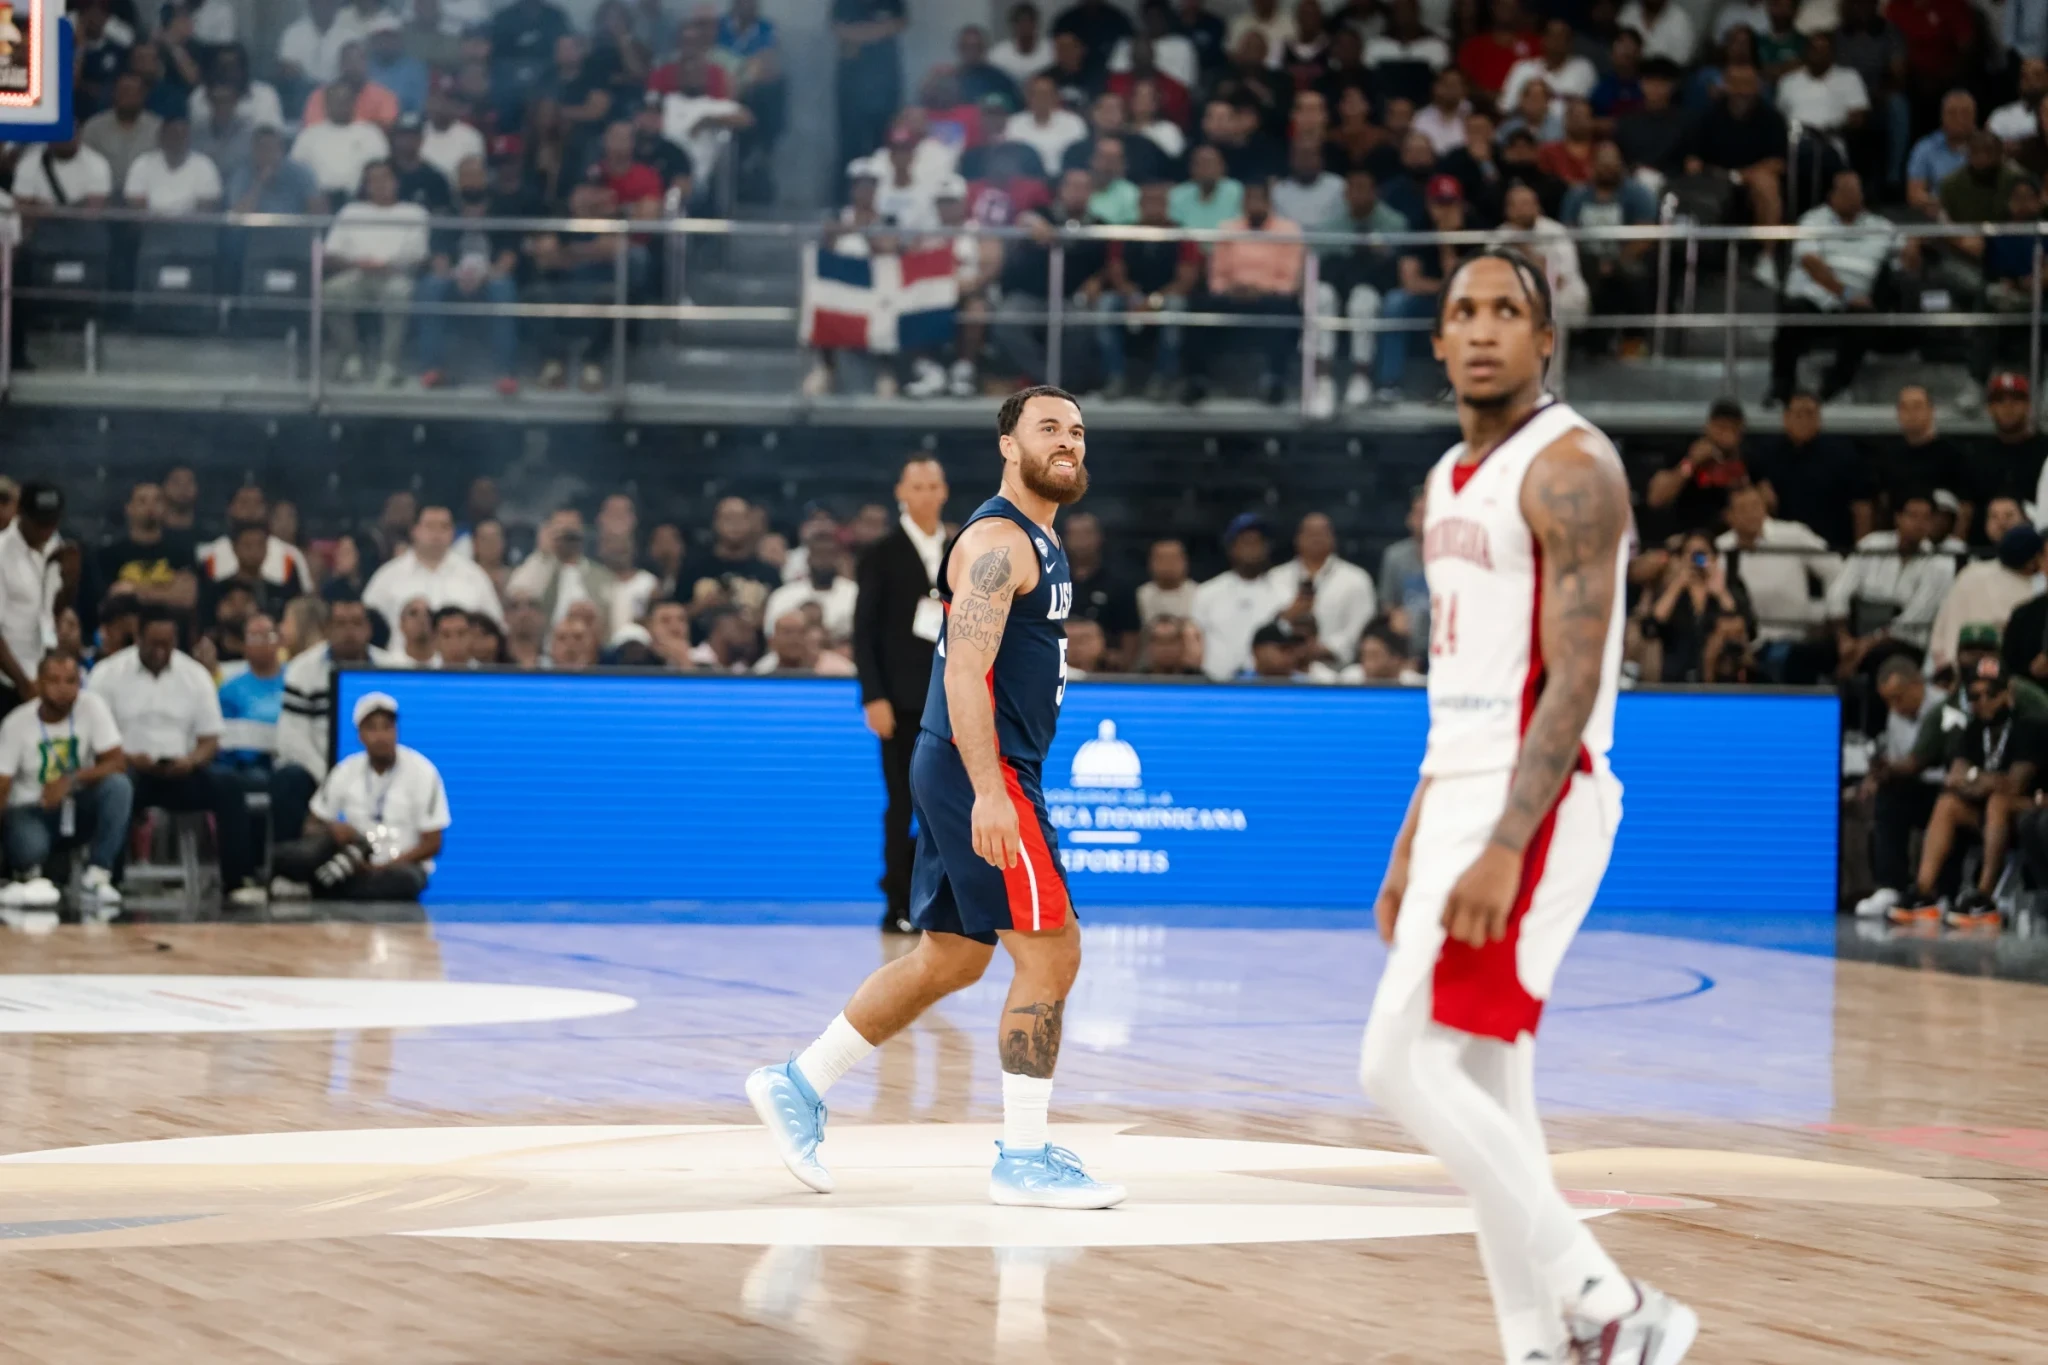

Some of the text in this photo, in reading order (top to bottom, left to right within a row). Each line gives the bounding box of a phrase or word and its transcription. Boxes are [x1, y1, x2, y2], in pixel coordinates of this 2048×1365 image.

[1055, 638, 1068, 706] 5
[1095, 806, 1247, 830] DOMINICANA
[1060, 849, 1170, 873] EPORTES
